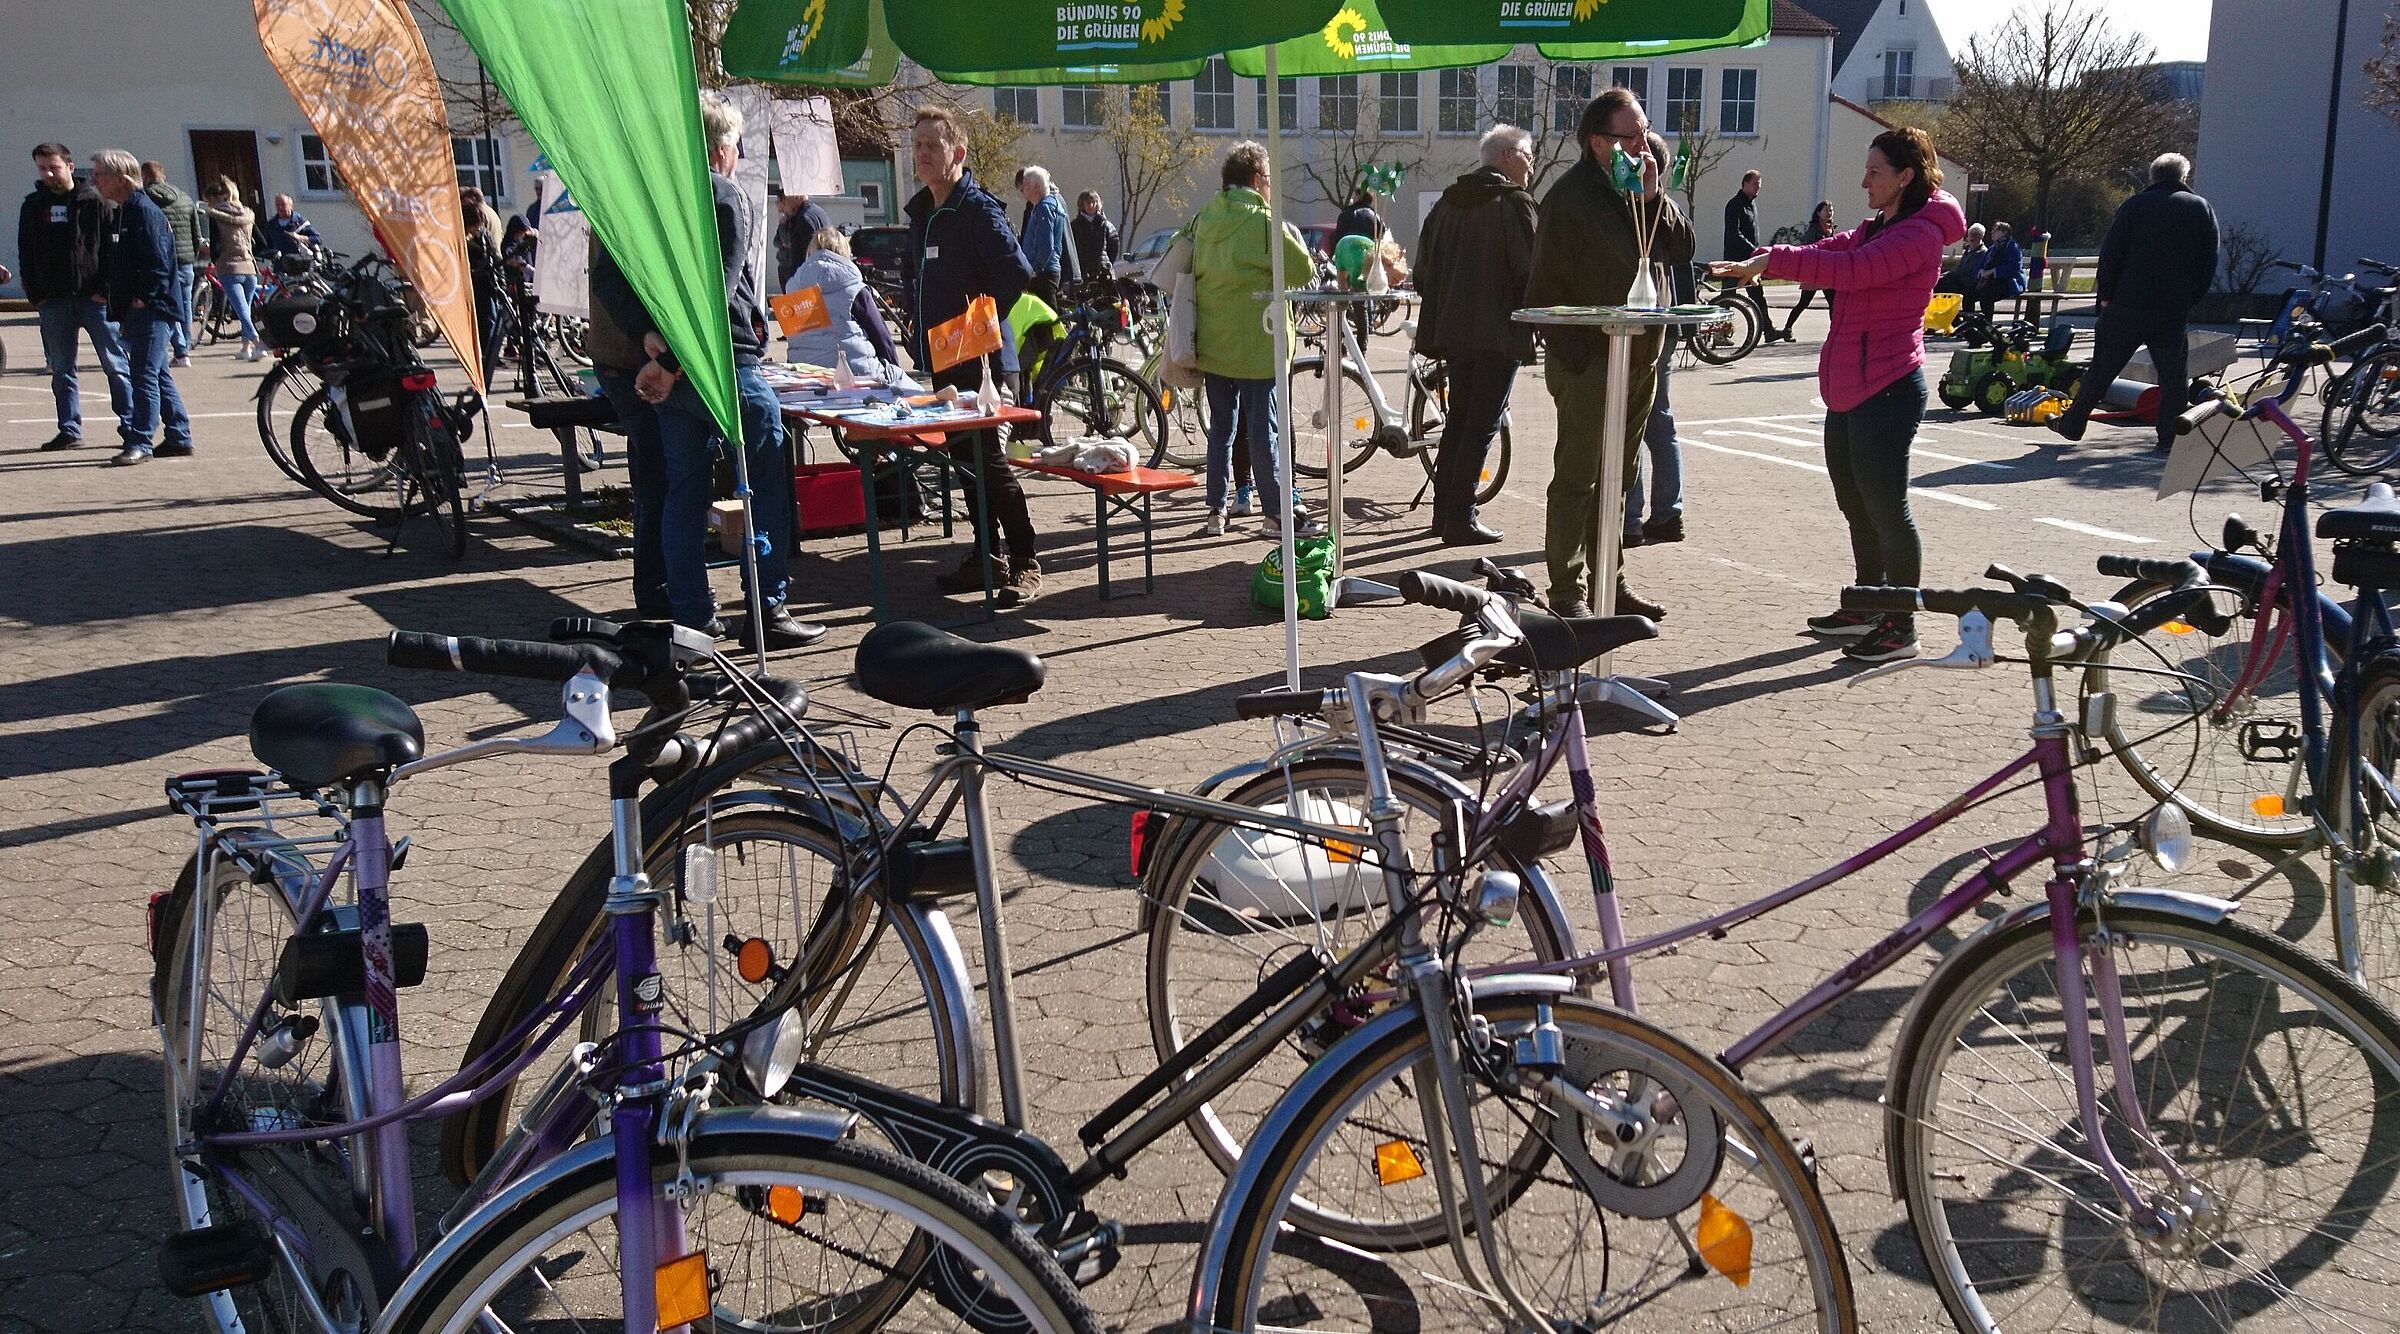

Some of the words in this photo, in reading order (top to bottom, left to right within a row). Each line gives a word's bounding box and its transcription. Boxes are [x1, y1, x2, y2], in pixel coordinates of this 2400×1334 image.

[1057, 3, 1118, 21] BÜNDNIS
[1123, 6, 1141, 20] 90
[1501, 2, 1521, 16] DIE
[1525, 0, 1574, 17] GRÜNEN
[1057, 25, 1079, 40] DIE
[1084, 20, 1140, 38] GRÜNEN
[793, 299, 815, 311] adfc
